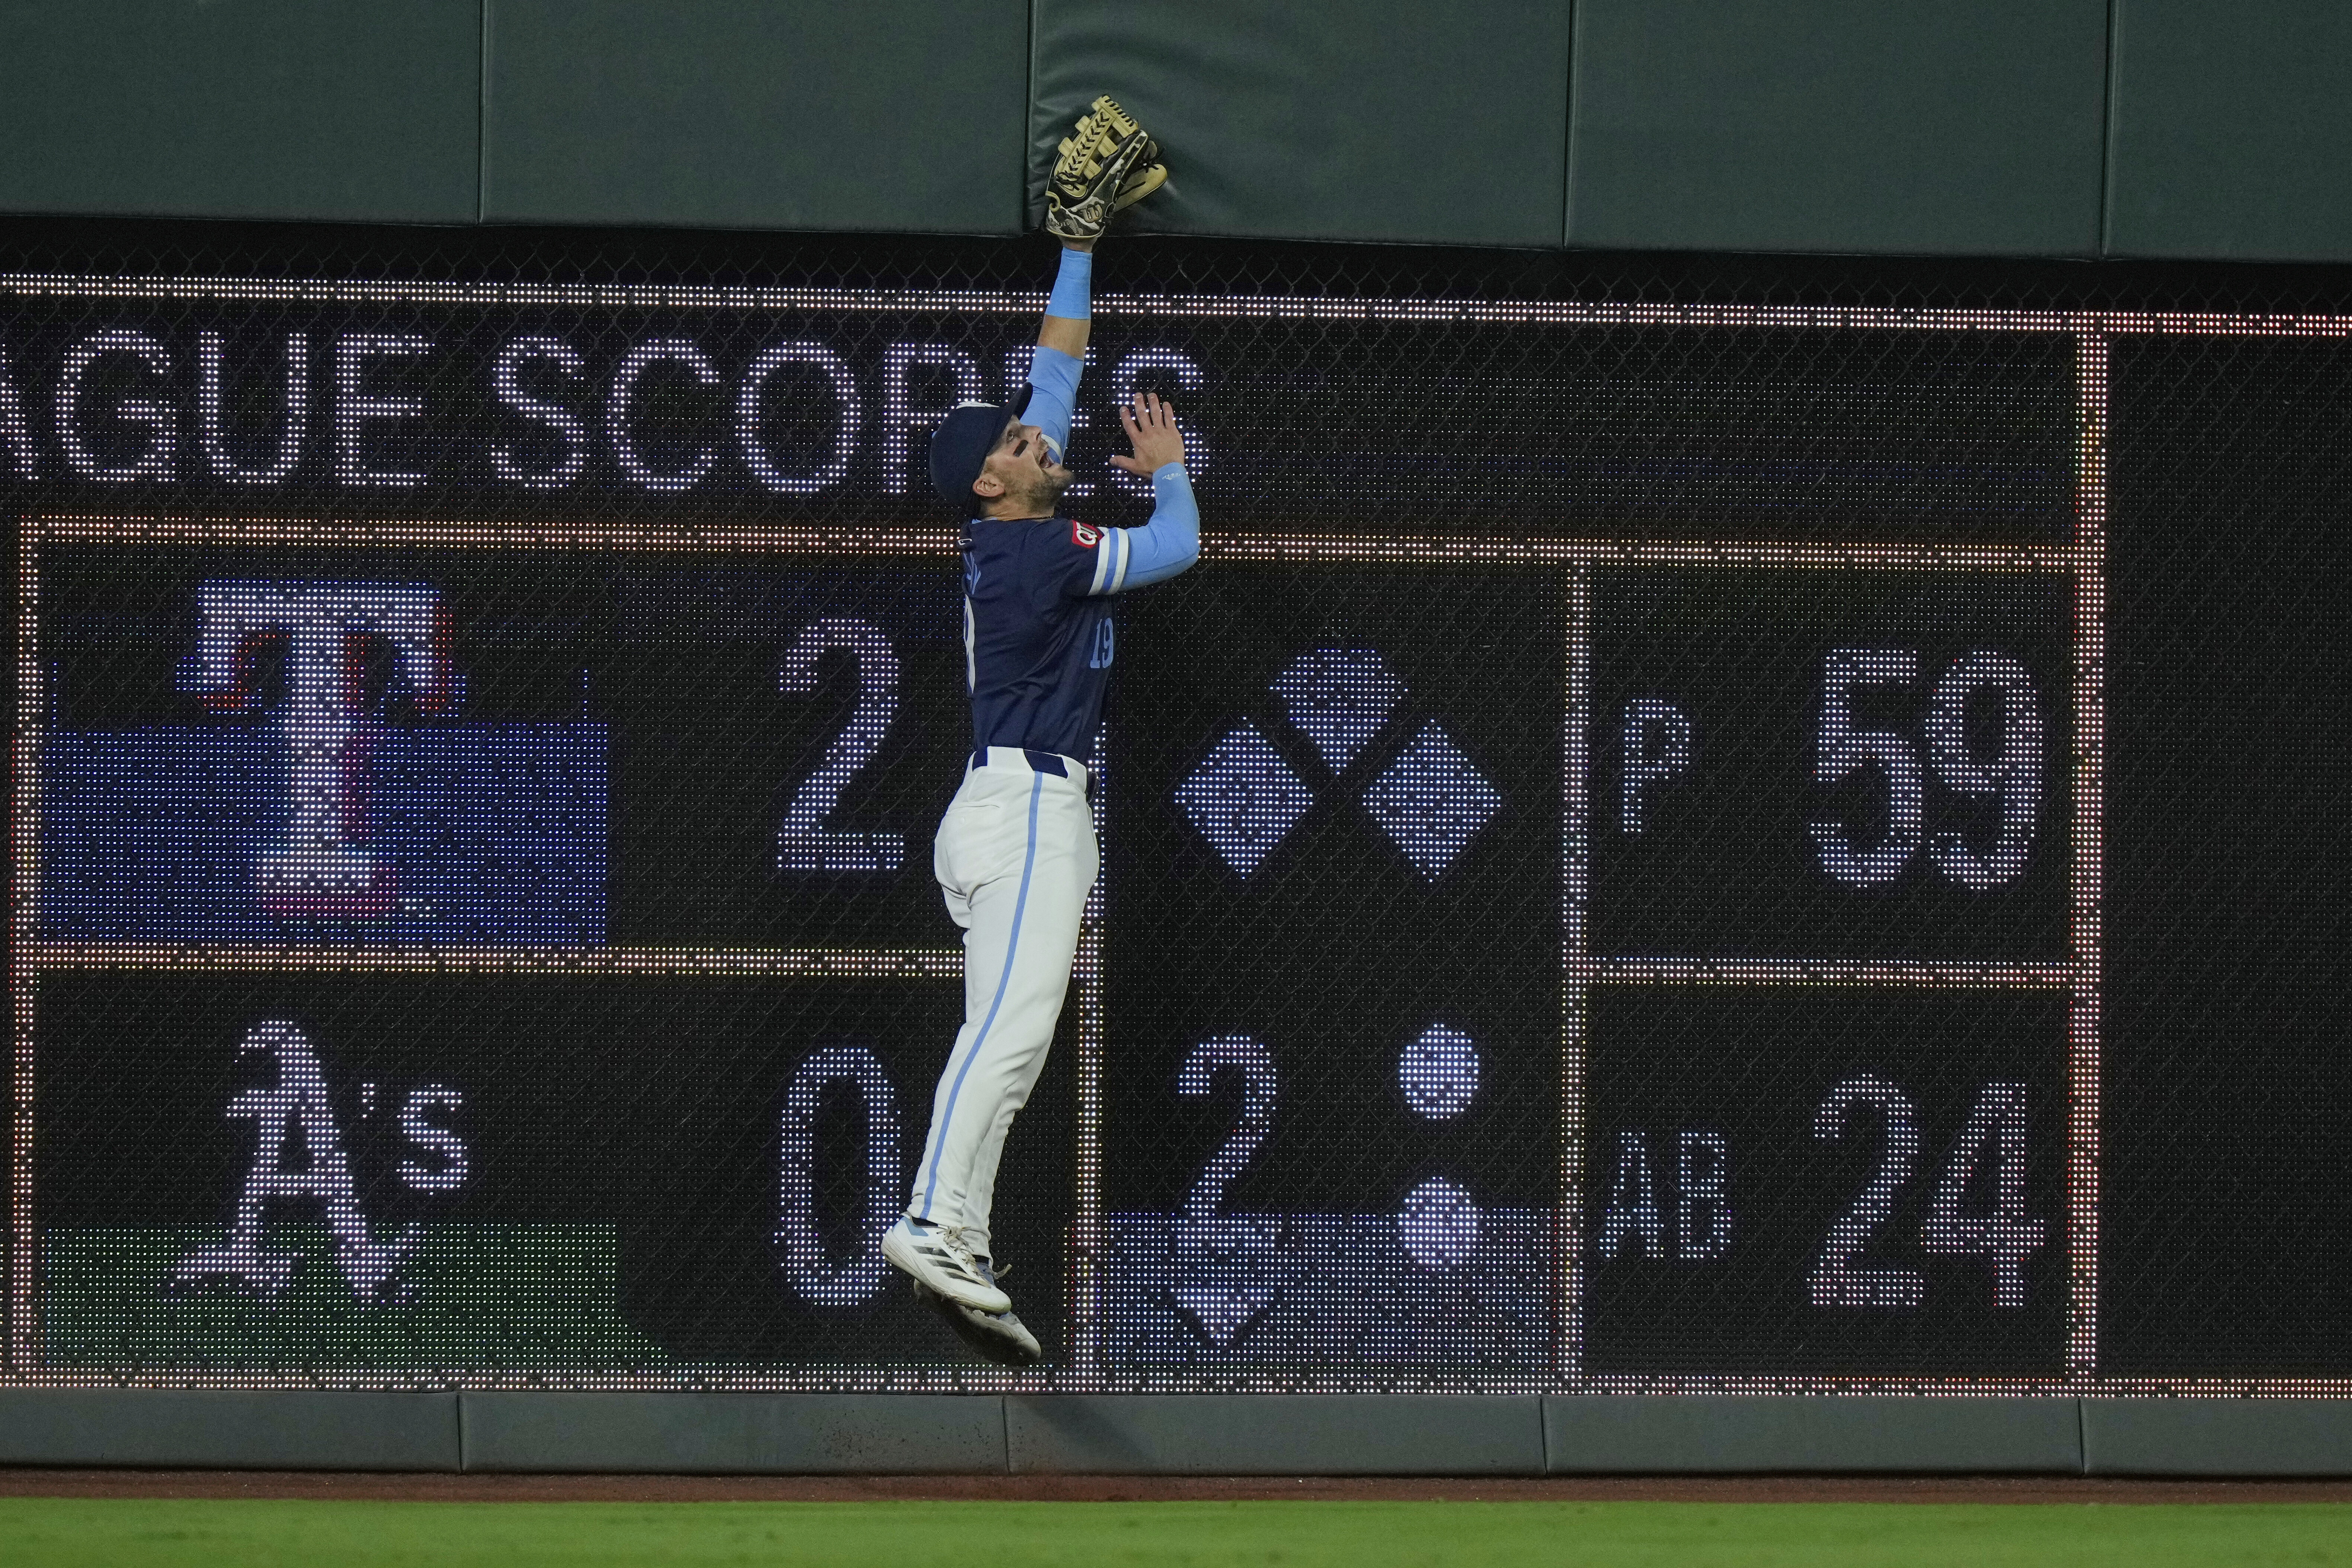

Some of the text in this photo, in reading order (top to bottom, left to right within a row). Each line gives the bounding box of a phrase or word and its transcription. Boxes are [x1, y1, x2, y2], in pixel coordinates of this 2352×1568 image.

[176, 580, 904, 916] T 2
[1090, 617, 1114, 669] 19
[1623, 649, 2043, 890] P 59
[774, 1049, 901, 1306] 0
[1176, 1036, 1277, 1247] 2
[1599, 1073, 2044, 1306] AB 24
